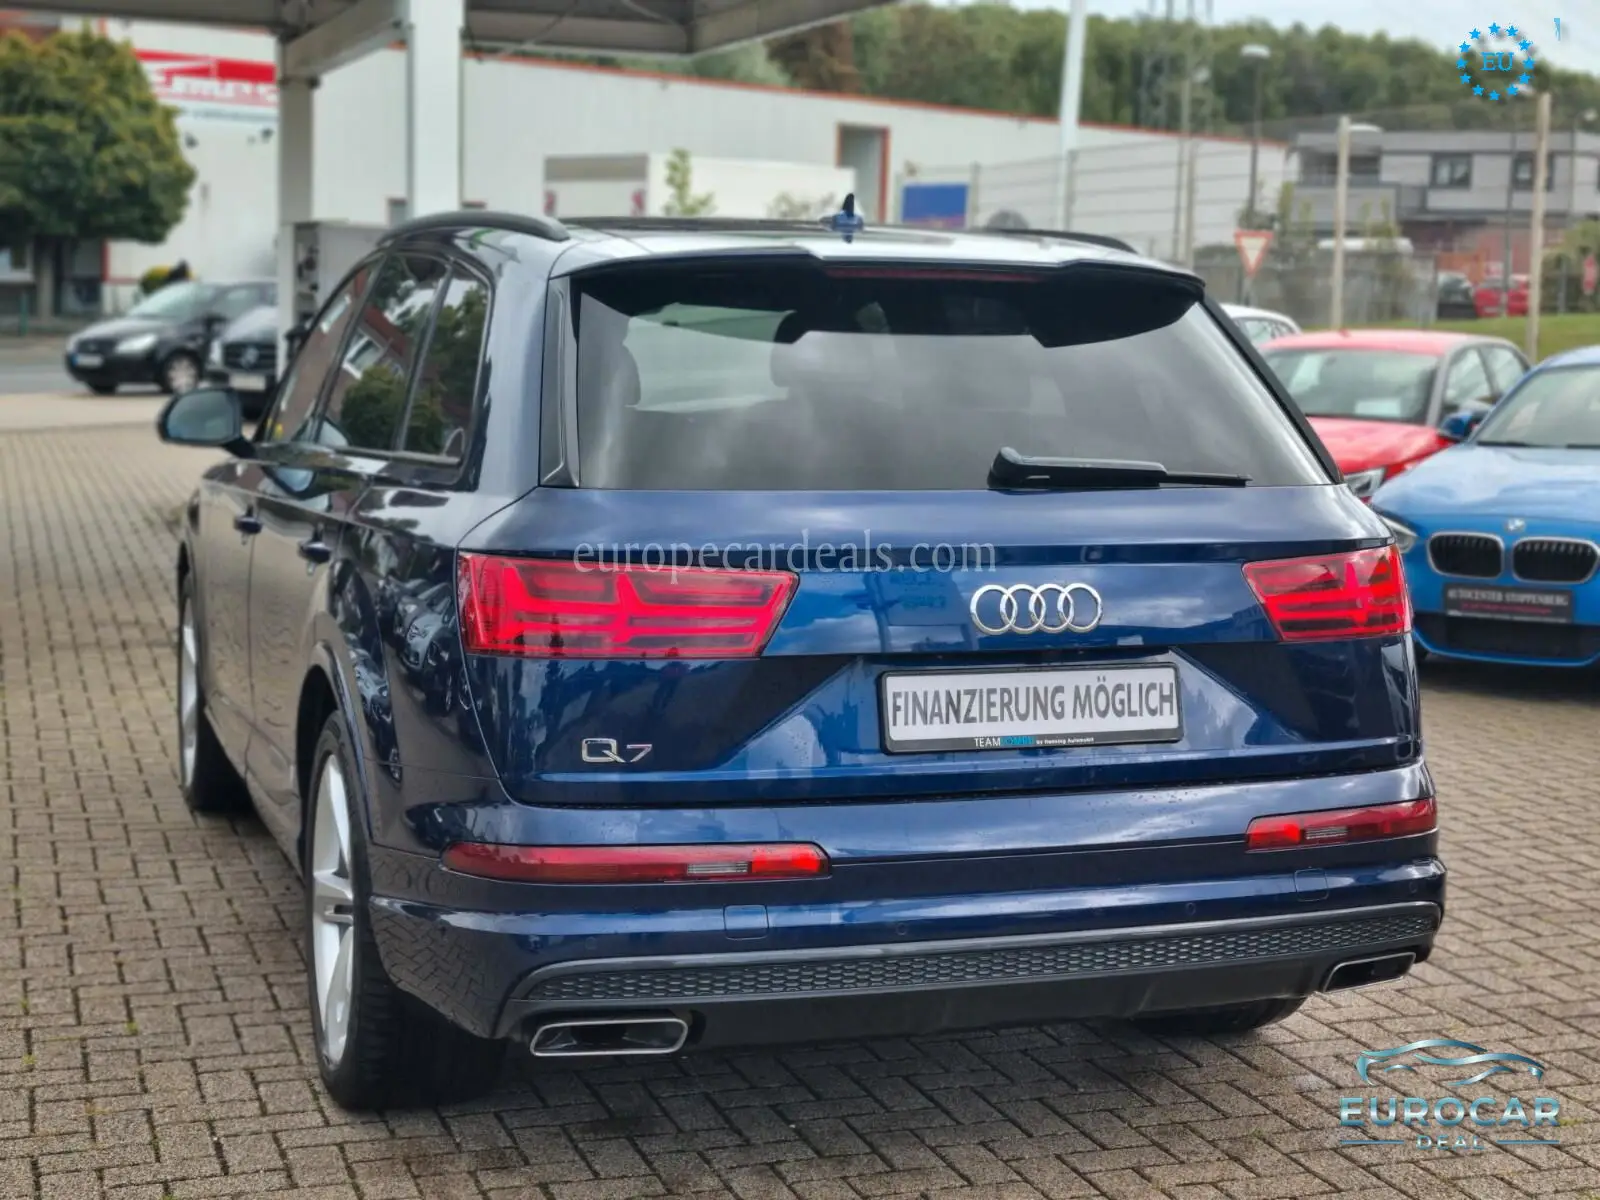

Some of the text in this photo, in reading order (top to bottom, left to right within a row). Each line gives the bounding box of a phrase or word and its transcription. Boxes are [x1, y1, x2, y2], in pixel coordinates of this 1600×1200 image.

[891, 675, 1175, 727] FINANZIERUNG MÖGLICH
[581, 737, 653, 763] Q7
